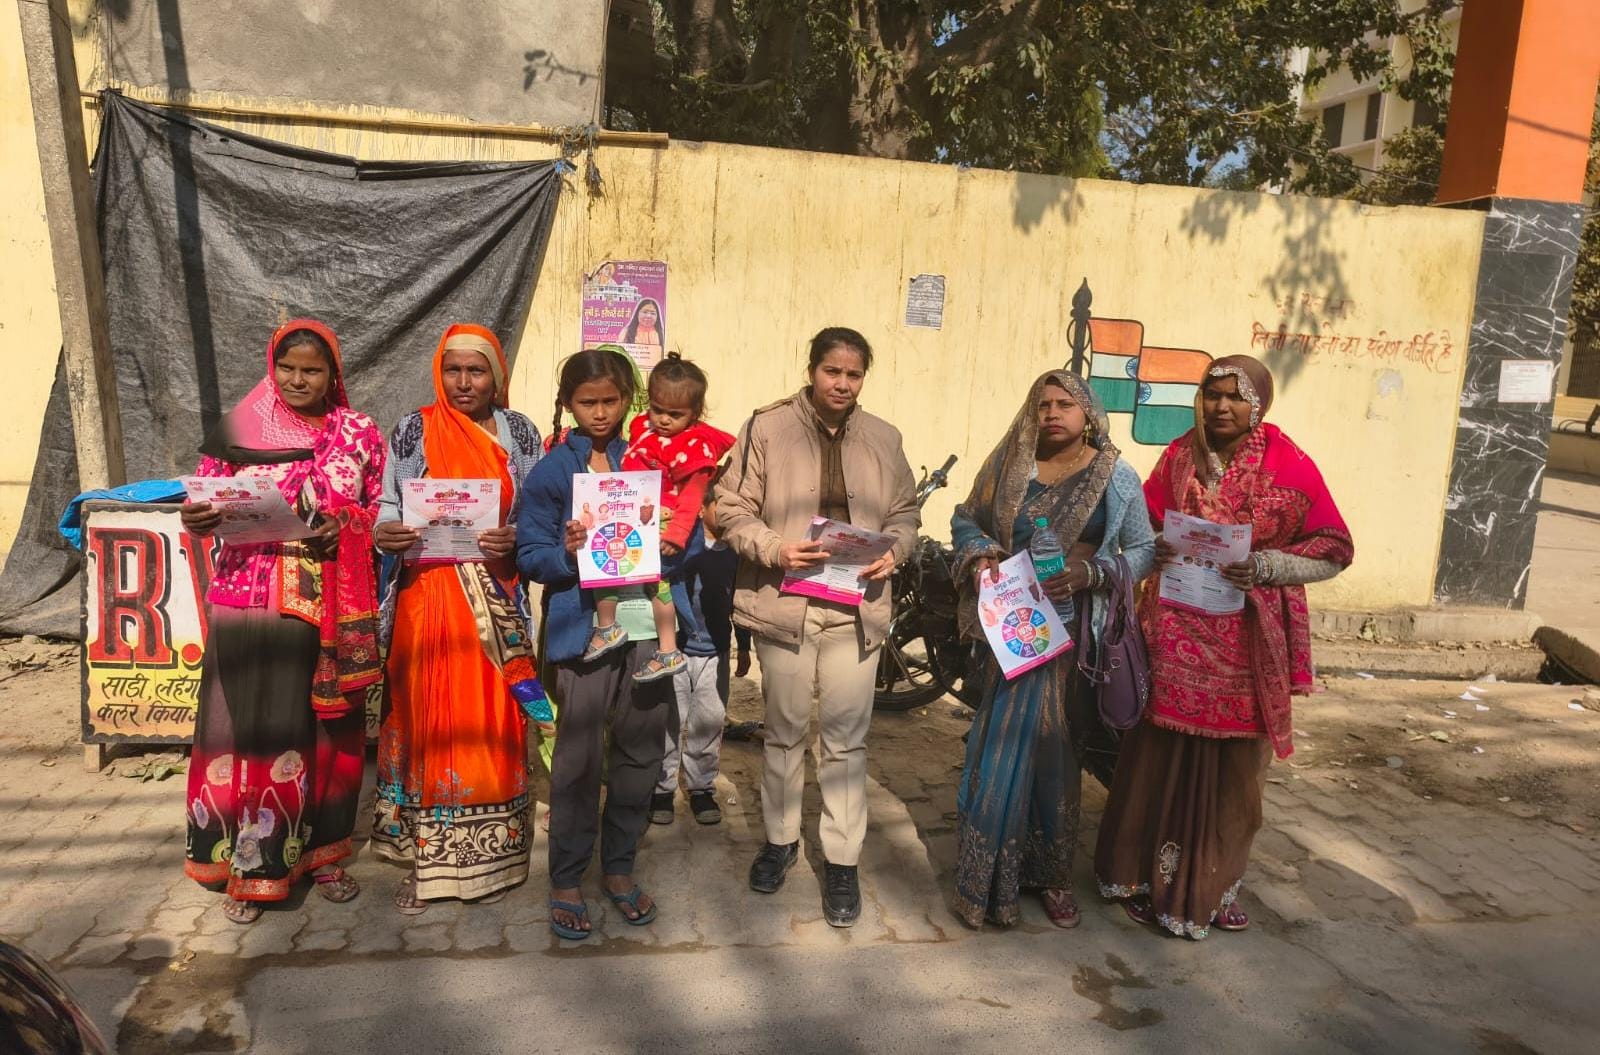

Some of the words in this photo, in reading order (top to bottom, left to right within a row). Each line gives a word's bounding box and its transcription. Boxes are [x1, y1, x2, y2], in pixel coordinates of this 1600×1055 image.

[1251, 320, 1287, 353] निजी
[1340, 335, 1361, 357] का
[1436, 329, 1457, 374] है
[97, 702, 141, 728] कलर
